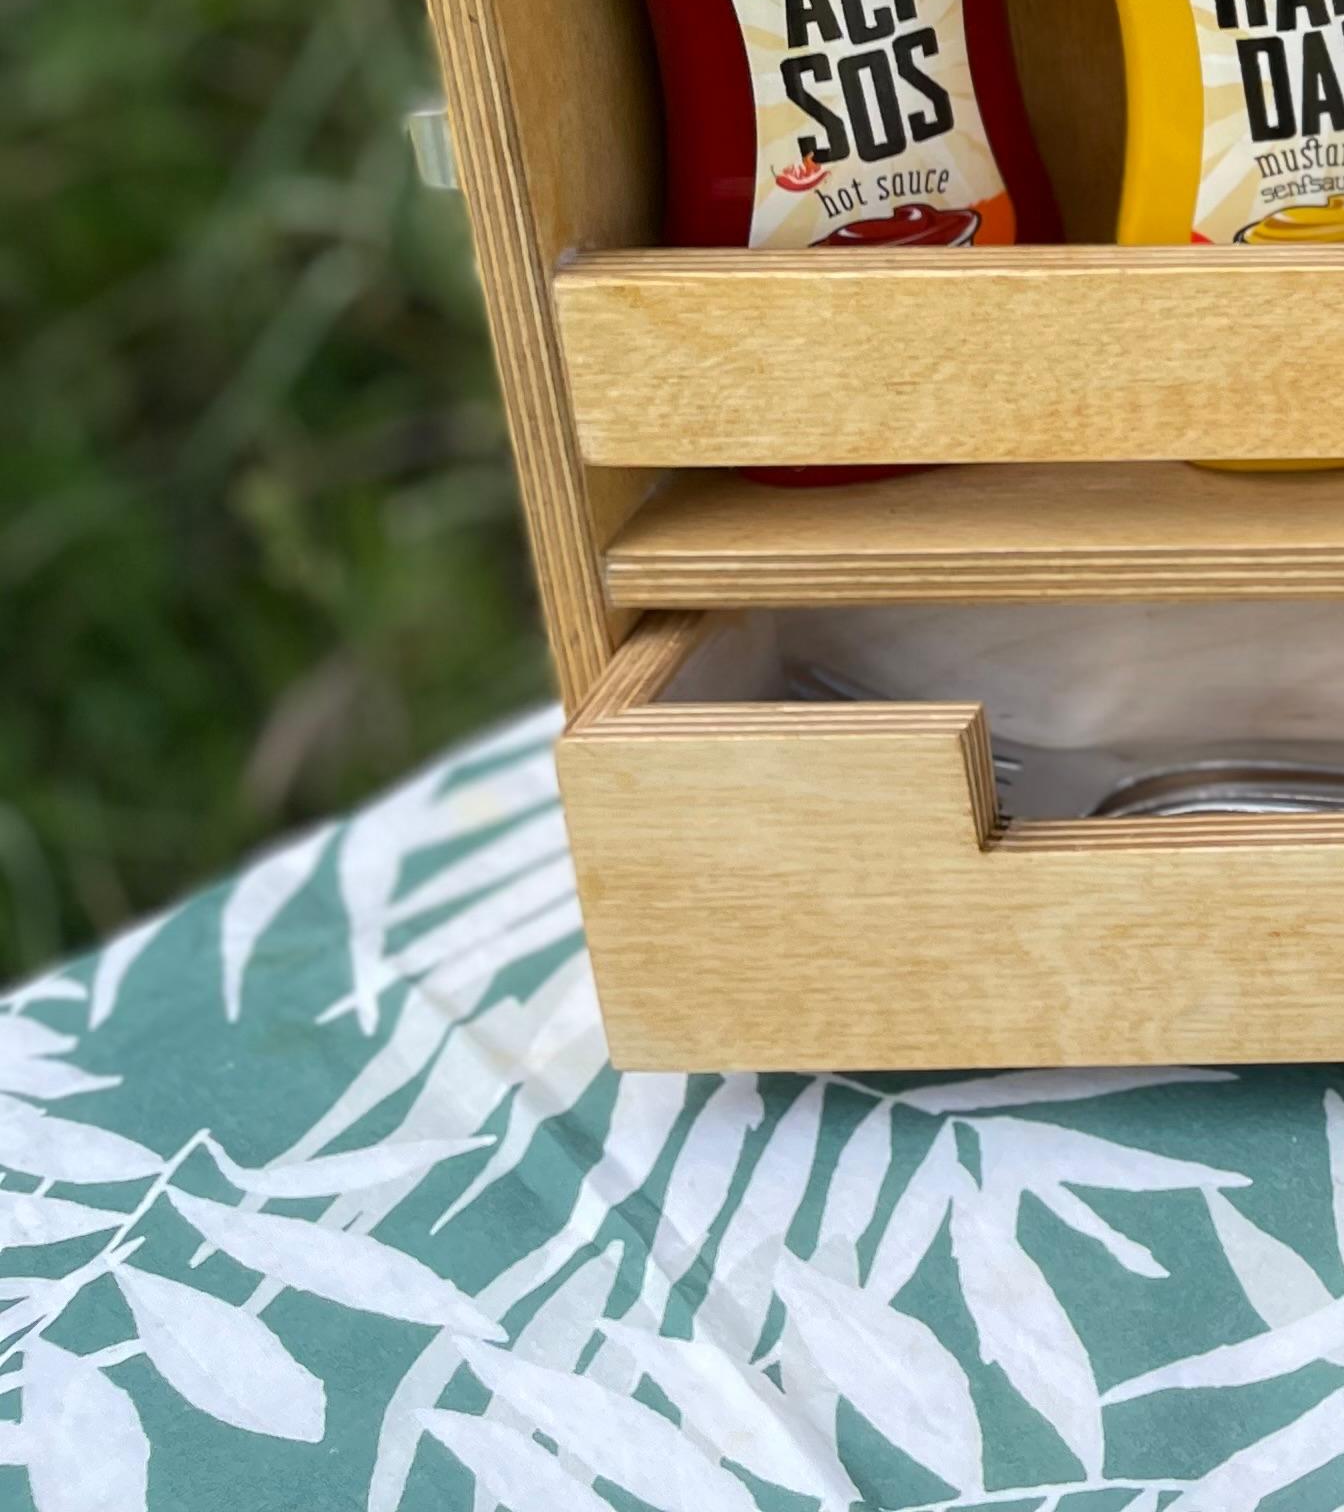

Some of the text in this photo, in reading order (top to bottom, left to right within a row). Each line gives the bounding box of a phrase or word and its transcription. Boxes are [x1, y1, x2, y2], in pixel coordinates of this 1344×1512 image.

[779, 26, 955, 165] SOS
[814, 168, 950, 219] hot sauce
